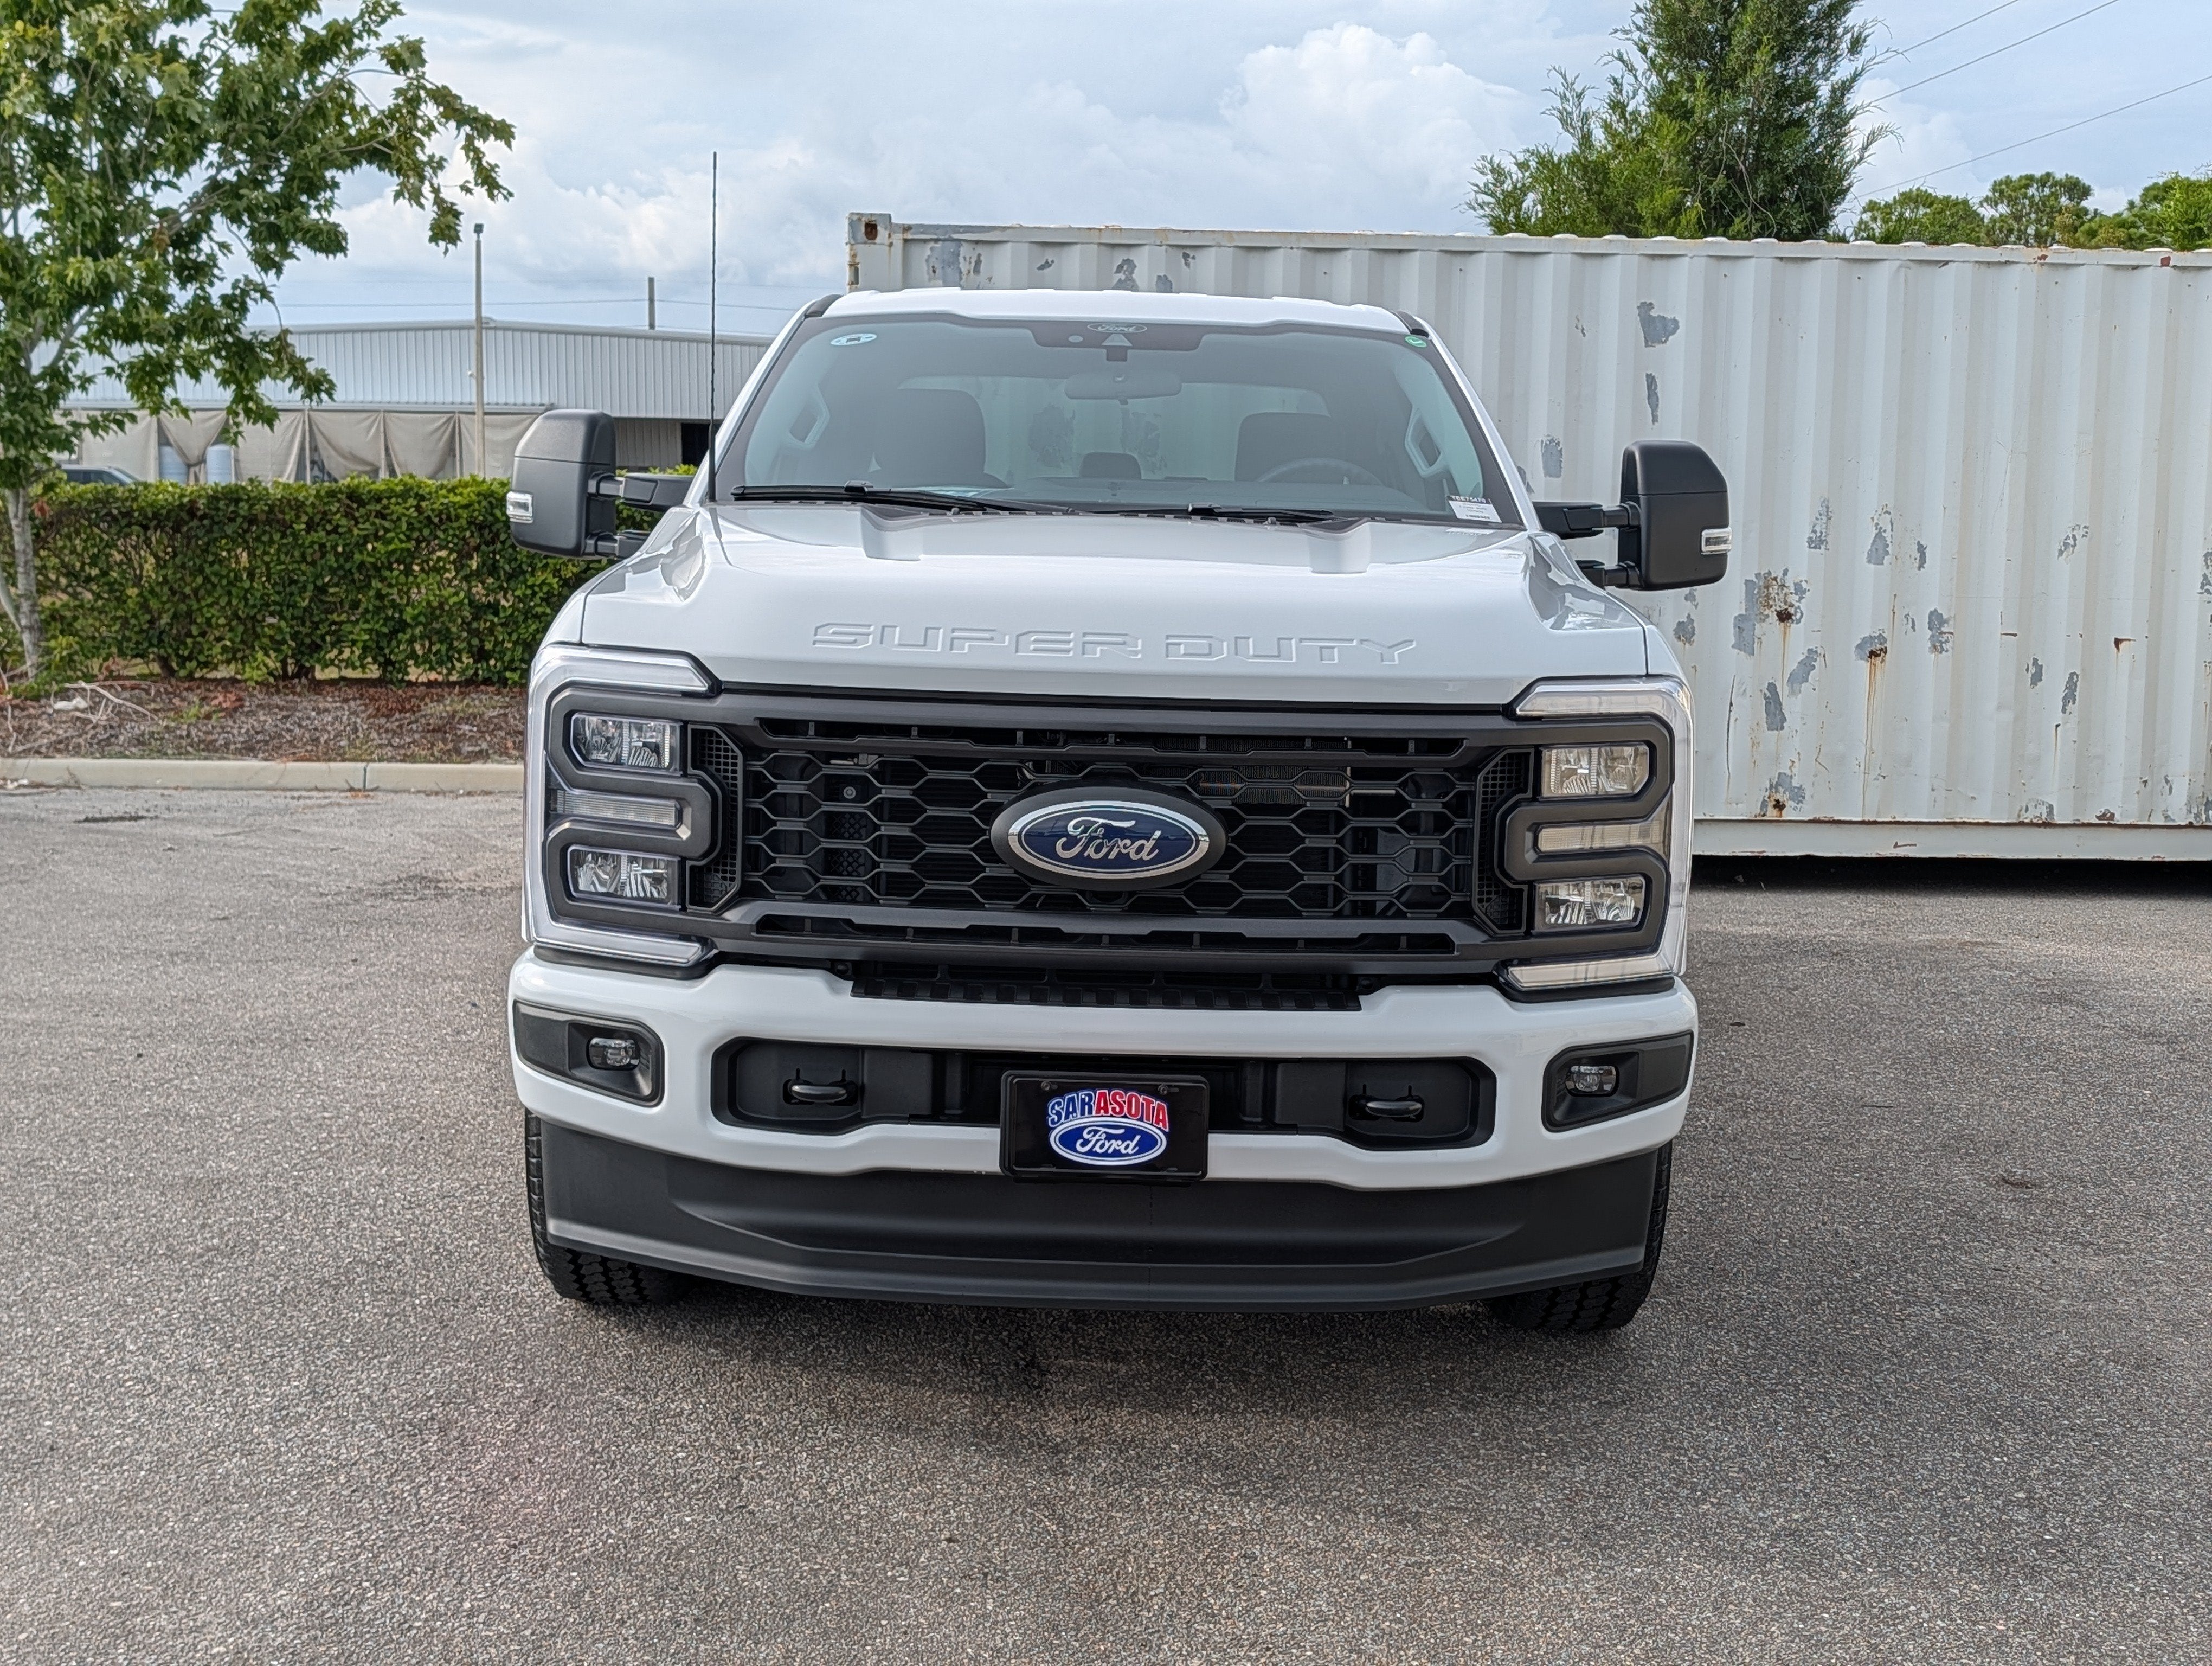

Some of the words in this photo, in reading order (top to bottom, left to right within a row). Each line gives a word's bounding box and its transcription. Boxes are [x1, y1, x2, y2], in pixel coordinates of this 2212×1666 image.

[813, 623, 1142, 658] SUPER
[1165, 633, 1417, 664] DUTY
[1056, 816, 1162, 861] Ford
[1047, 1090, 1169, 1132] SARASOTA
[1076, 1126, 1142, 1154] Ford
